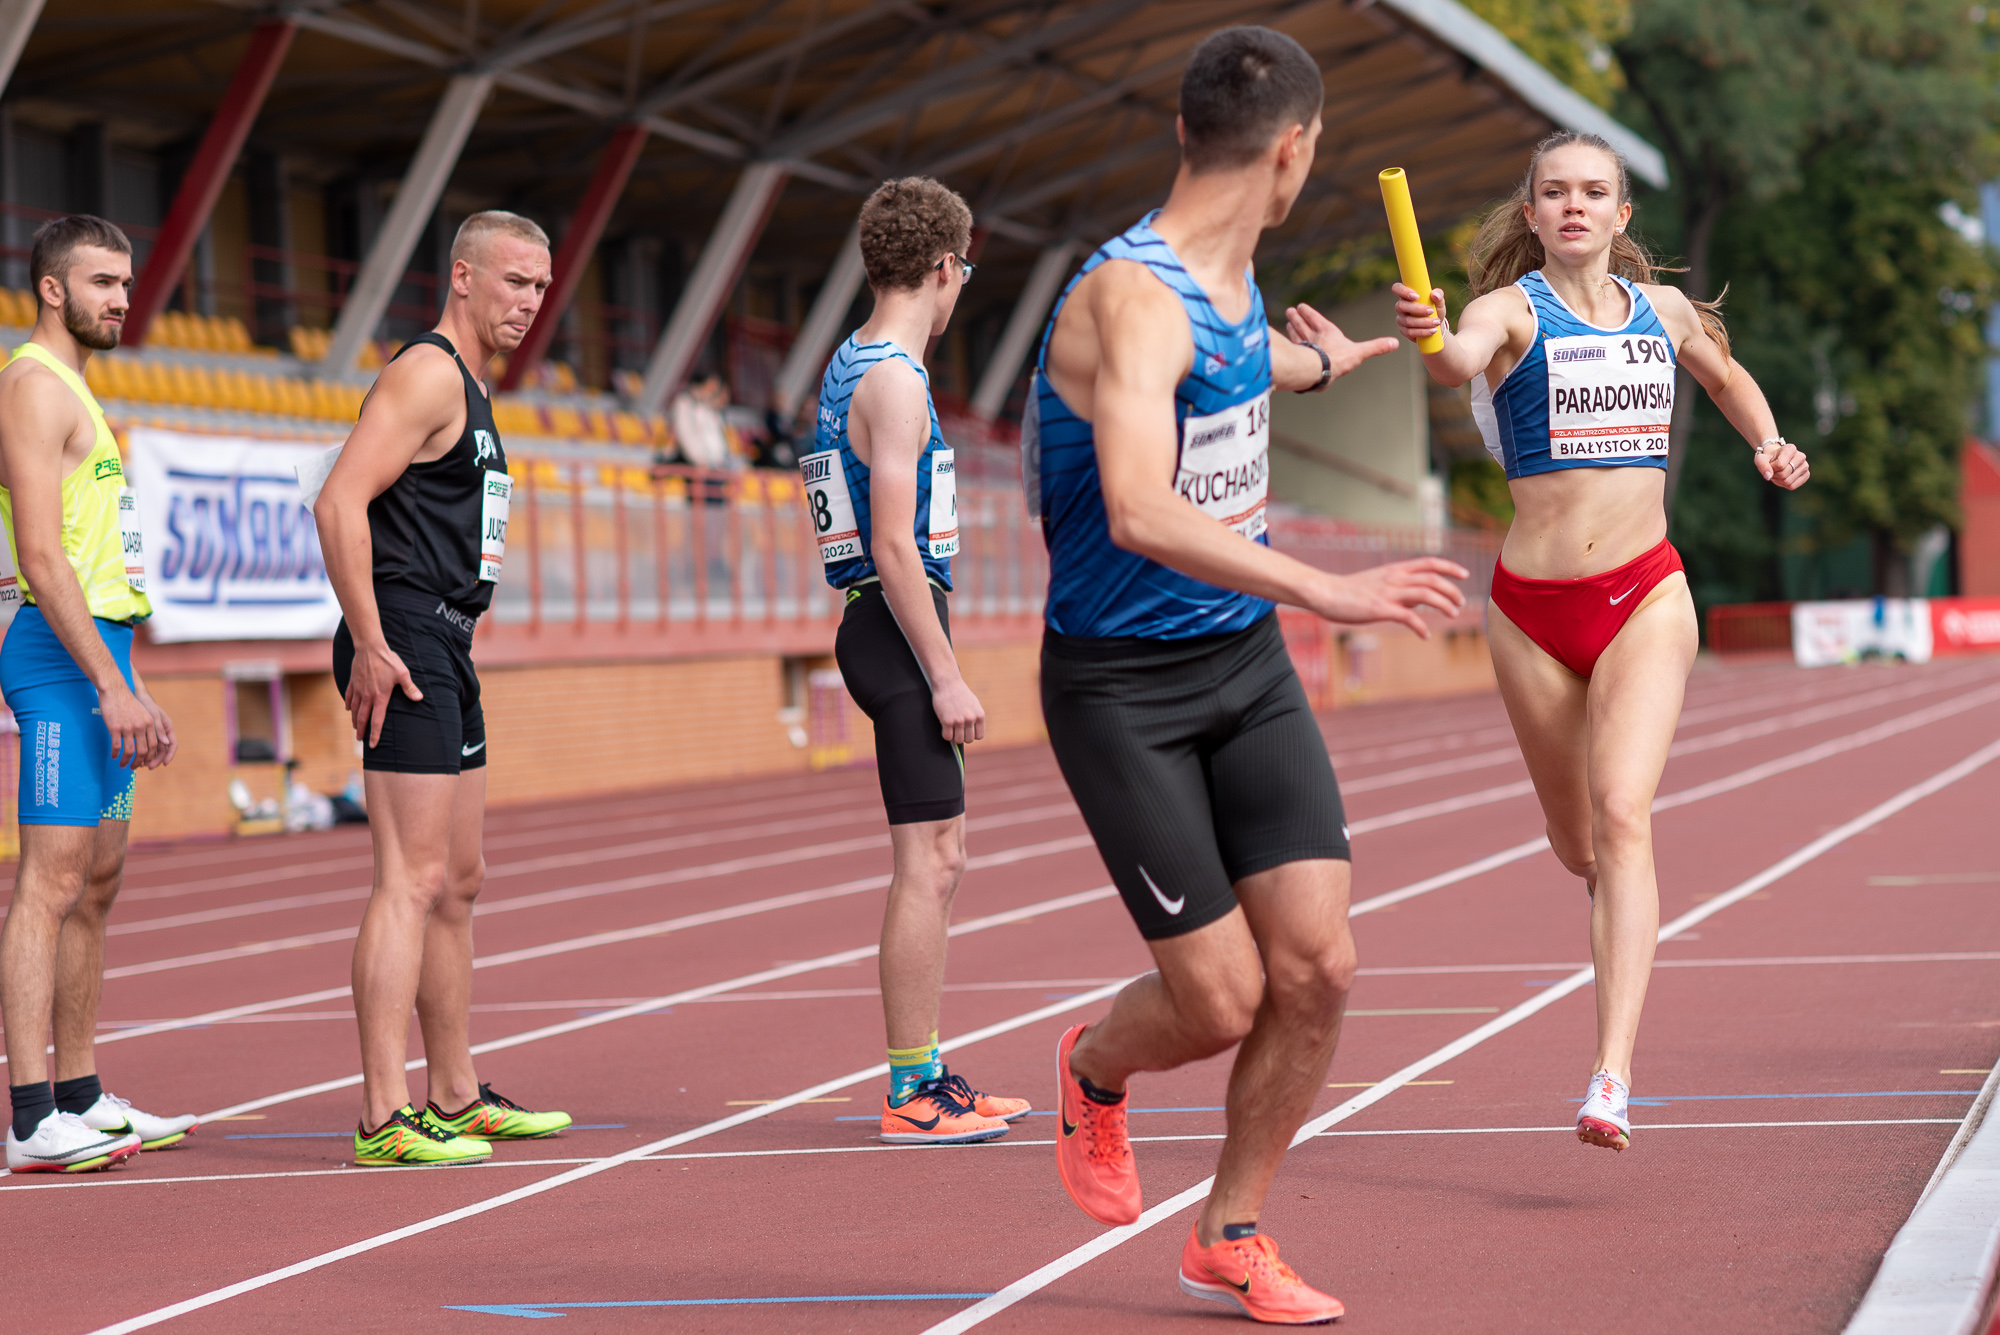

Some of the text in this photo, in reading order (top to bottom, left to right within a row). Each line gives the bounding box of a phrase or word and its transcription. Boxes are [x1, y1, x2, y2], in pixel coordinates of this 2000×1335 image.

[1553, 347, 1606, 362] SONAROL
[1621, 339, 1667, 364] 190
[1555, 383, 1672, 414] PARADOWSKA
[1573, 428, 1617, 436] MISTRZOSTWA
[1560, 439, 1641, 455] BIAŁYSTOK
[824, 543, 854, 559] 2022
[47, 749, 60, 808] SPORTOWY
